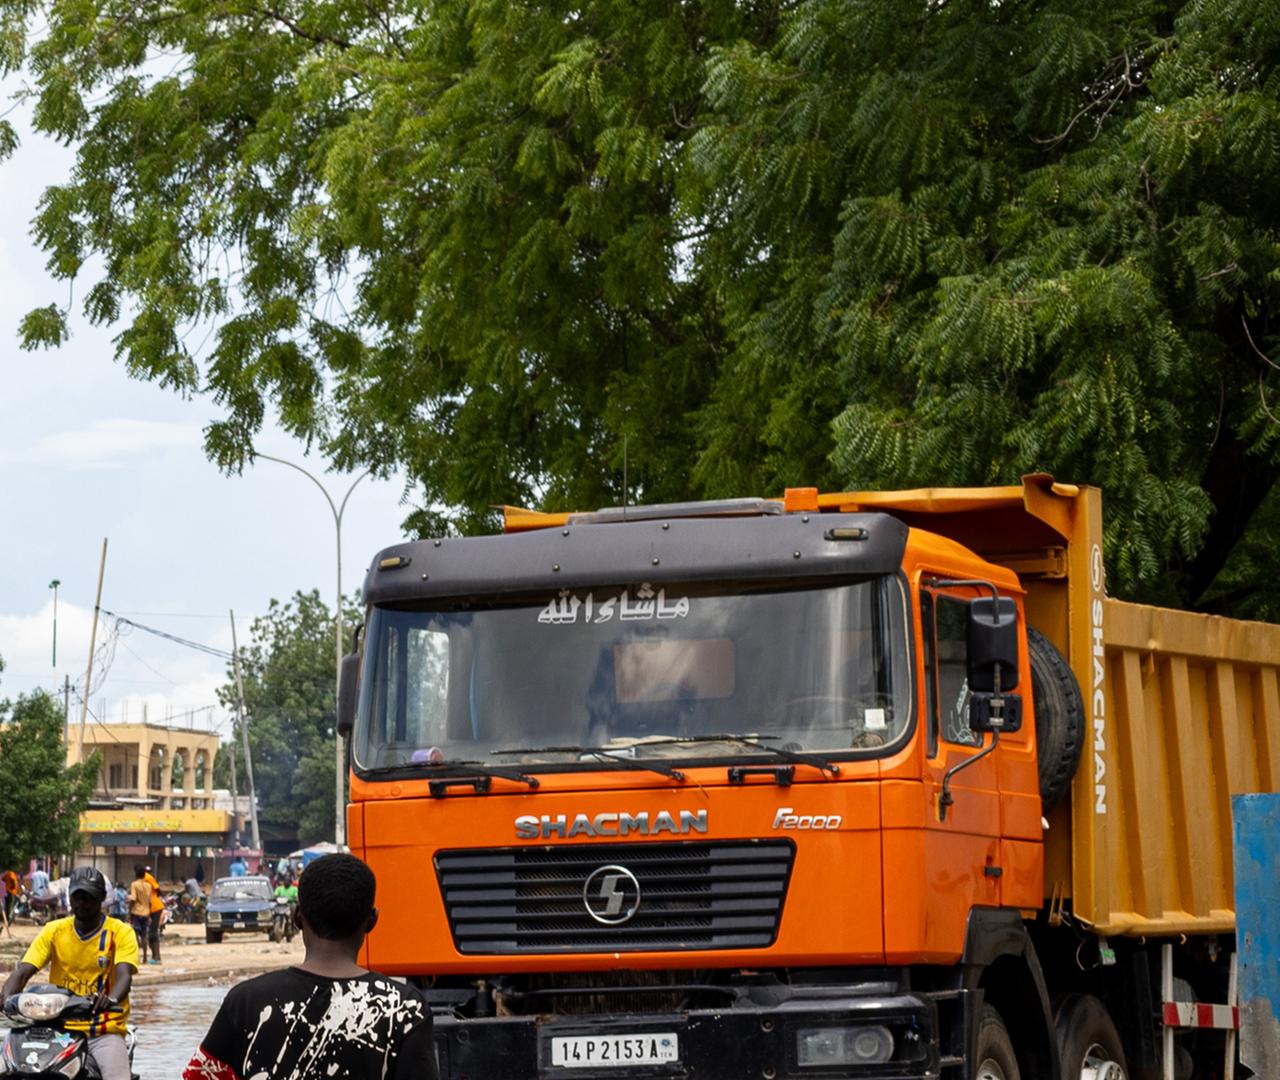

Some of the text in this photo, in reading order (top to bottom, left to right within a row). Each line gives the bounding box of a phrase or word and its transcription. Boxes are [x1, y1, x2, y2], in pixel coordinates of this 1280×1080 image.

[1092, 599, 1107, 814] SHACMAN
[515, 809, 708, 839] SHACMAN
[772, 807, 842, 830] F2000
